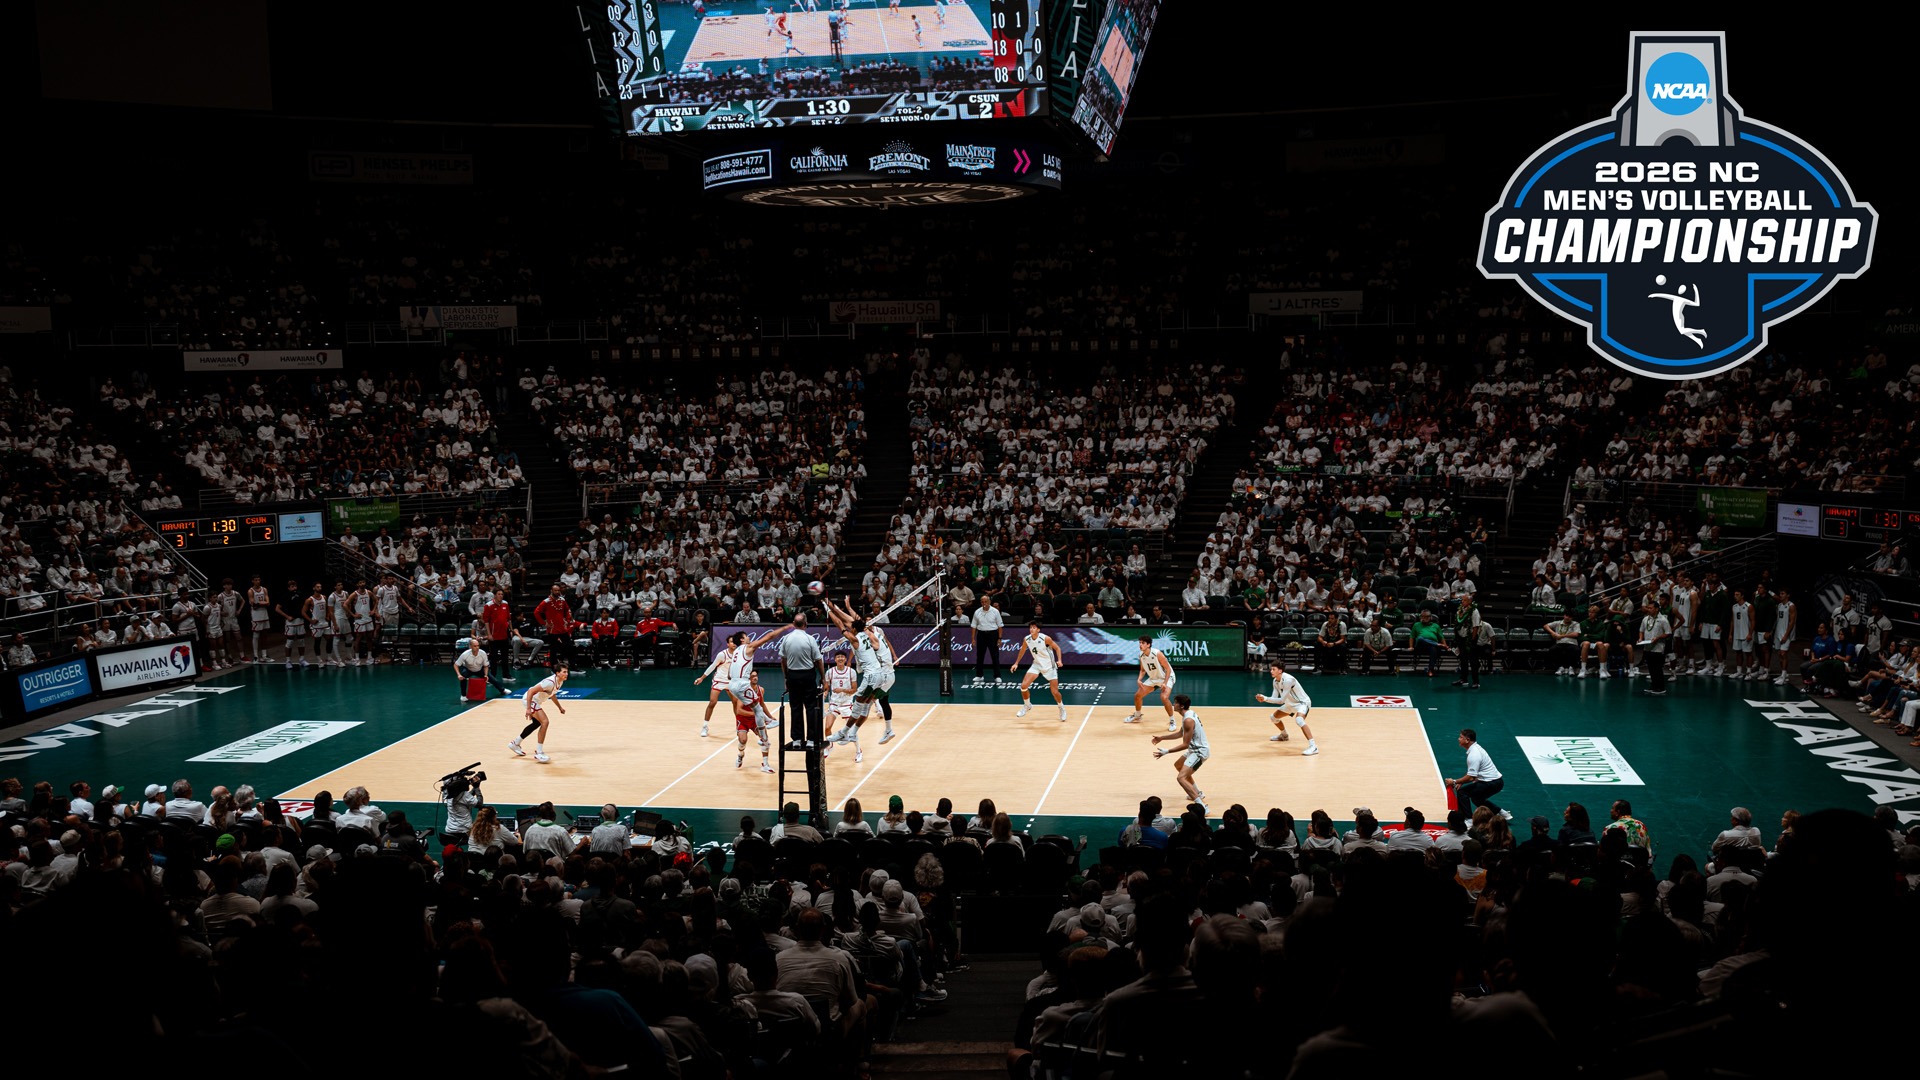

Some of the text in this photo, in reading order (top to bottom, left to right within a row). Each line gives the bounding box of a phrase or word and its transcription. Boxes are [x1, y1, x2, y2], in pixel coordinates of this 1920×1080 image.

[607, 3, 653, 20] 09 1 3
[992, 10, 1040, 29] 10 1 1
[612, 30, 656, 47] 13 0 0
[994, 39, 1007, 56] 18
[1016, 38, 1023, 55] 0
[1034, 37, 1042, 54] 0
[616, 56, 660, 74] 16 0 0
[994, 64, 1043, 83] 08 0 0
[619, 82, 664, 100] 23 1 1
[968, 94, 1000, 104] CSUN
[655, 106, 700, 117] HAWAI'I
[807, 100, 850, 115] 1:30
[979, 103, 994, 120] 2
[670, 116, 684, 132] 3
[364, 158, 470, 171] HENSEL PHELPS
[720, 155, 764, 170] 808-591-4777
[790, 155, 848, 170] CALIFORNIA
[868, 152, 931, 171] FREMONT
[1043, 154, 1055, 168] LAS
[1043, 169, 1047, 177] 6
[859, 302, 936, 316] HawaiiUSA
[1285, 298, 1340, 314] ALTRES
[212, 518, 237, 532] 1:30
[245, 516, 267, 525] CSUN
[1874, 512, 1898, 527] 1:30
[176, 534, 184, 548] 3
[223, 536, 229, 545] 2
[264, 527, 272, 540] 2
[102, 656, 168, 678] HAWAIIAN
[1147, 663, 1157, 672] 13
[23, 663, 82, 692] OUTRIGGER
[40, 692, 56, 704] RESORTS
[60, 689, 75, 699] HOTELS
[1554, 738, 1622, 783] CALIFORNIA
